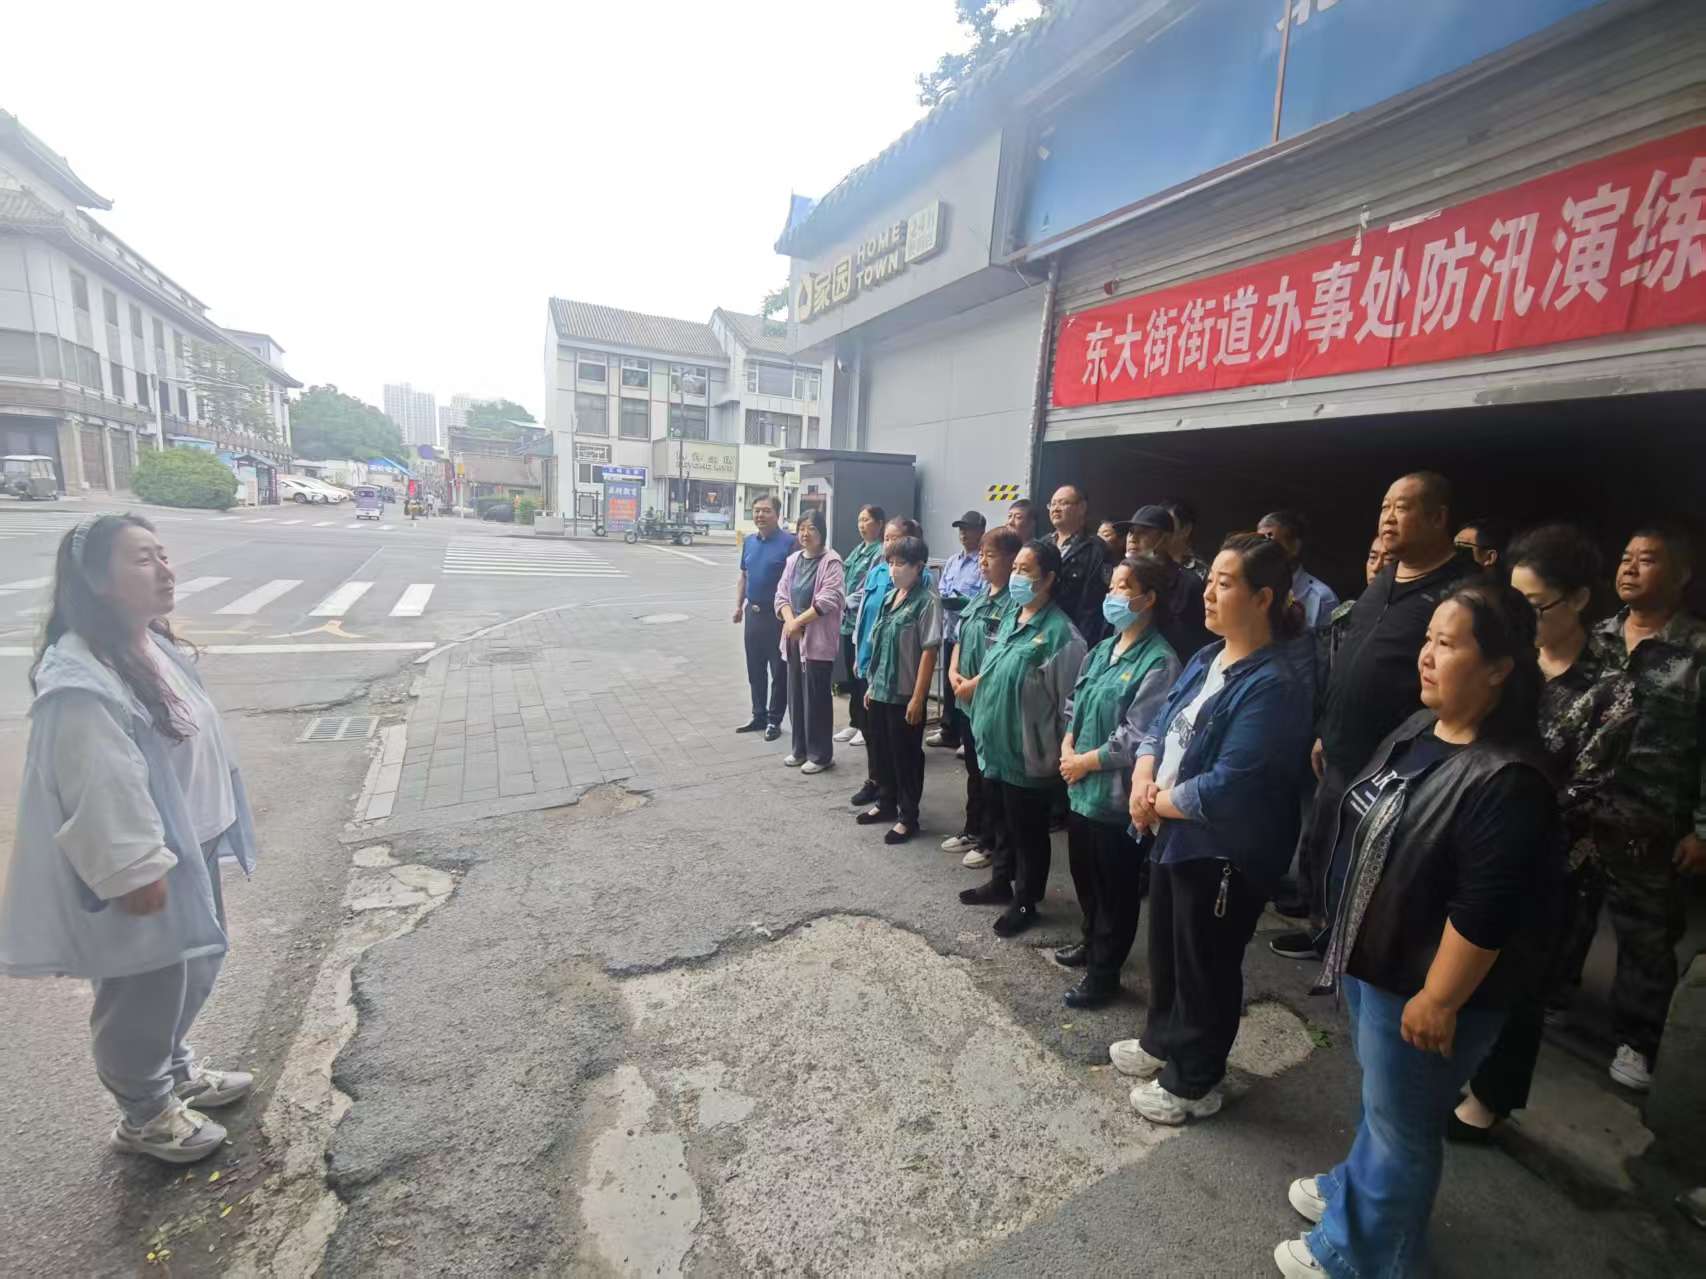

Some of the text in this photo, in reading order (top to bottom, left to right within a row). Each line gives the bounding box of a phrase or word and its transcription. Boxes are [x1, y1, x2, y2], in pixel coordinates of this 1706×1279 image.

[857, 222, 902, 266] HOME
[856, 252, 899, 289] TOWN
[1082, 157, 1706, 386] 东大街街道办事处防汛演练
